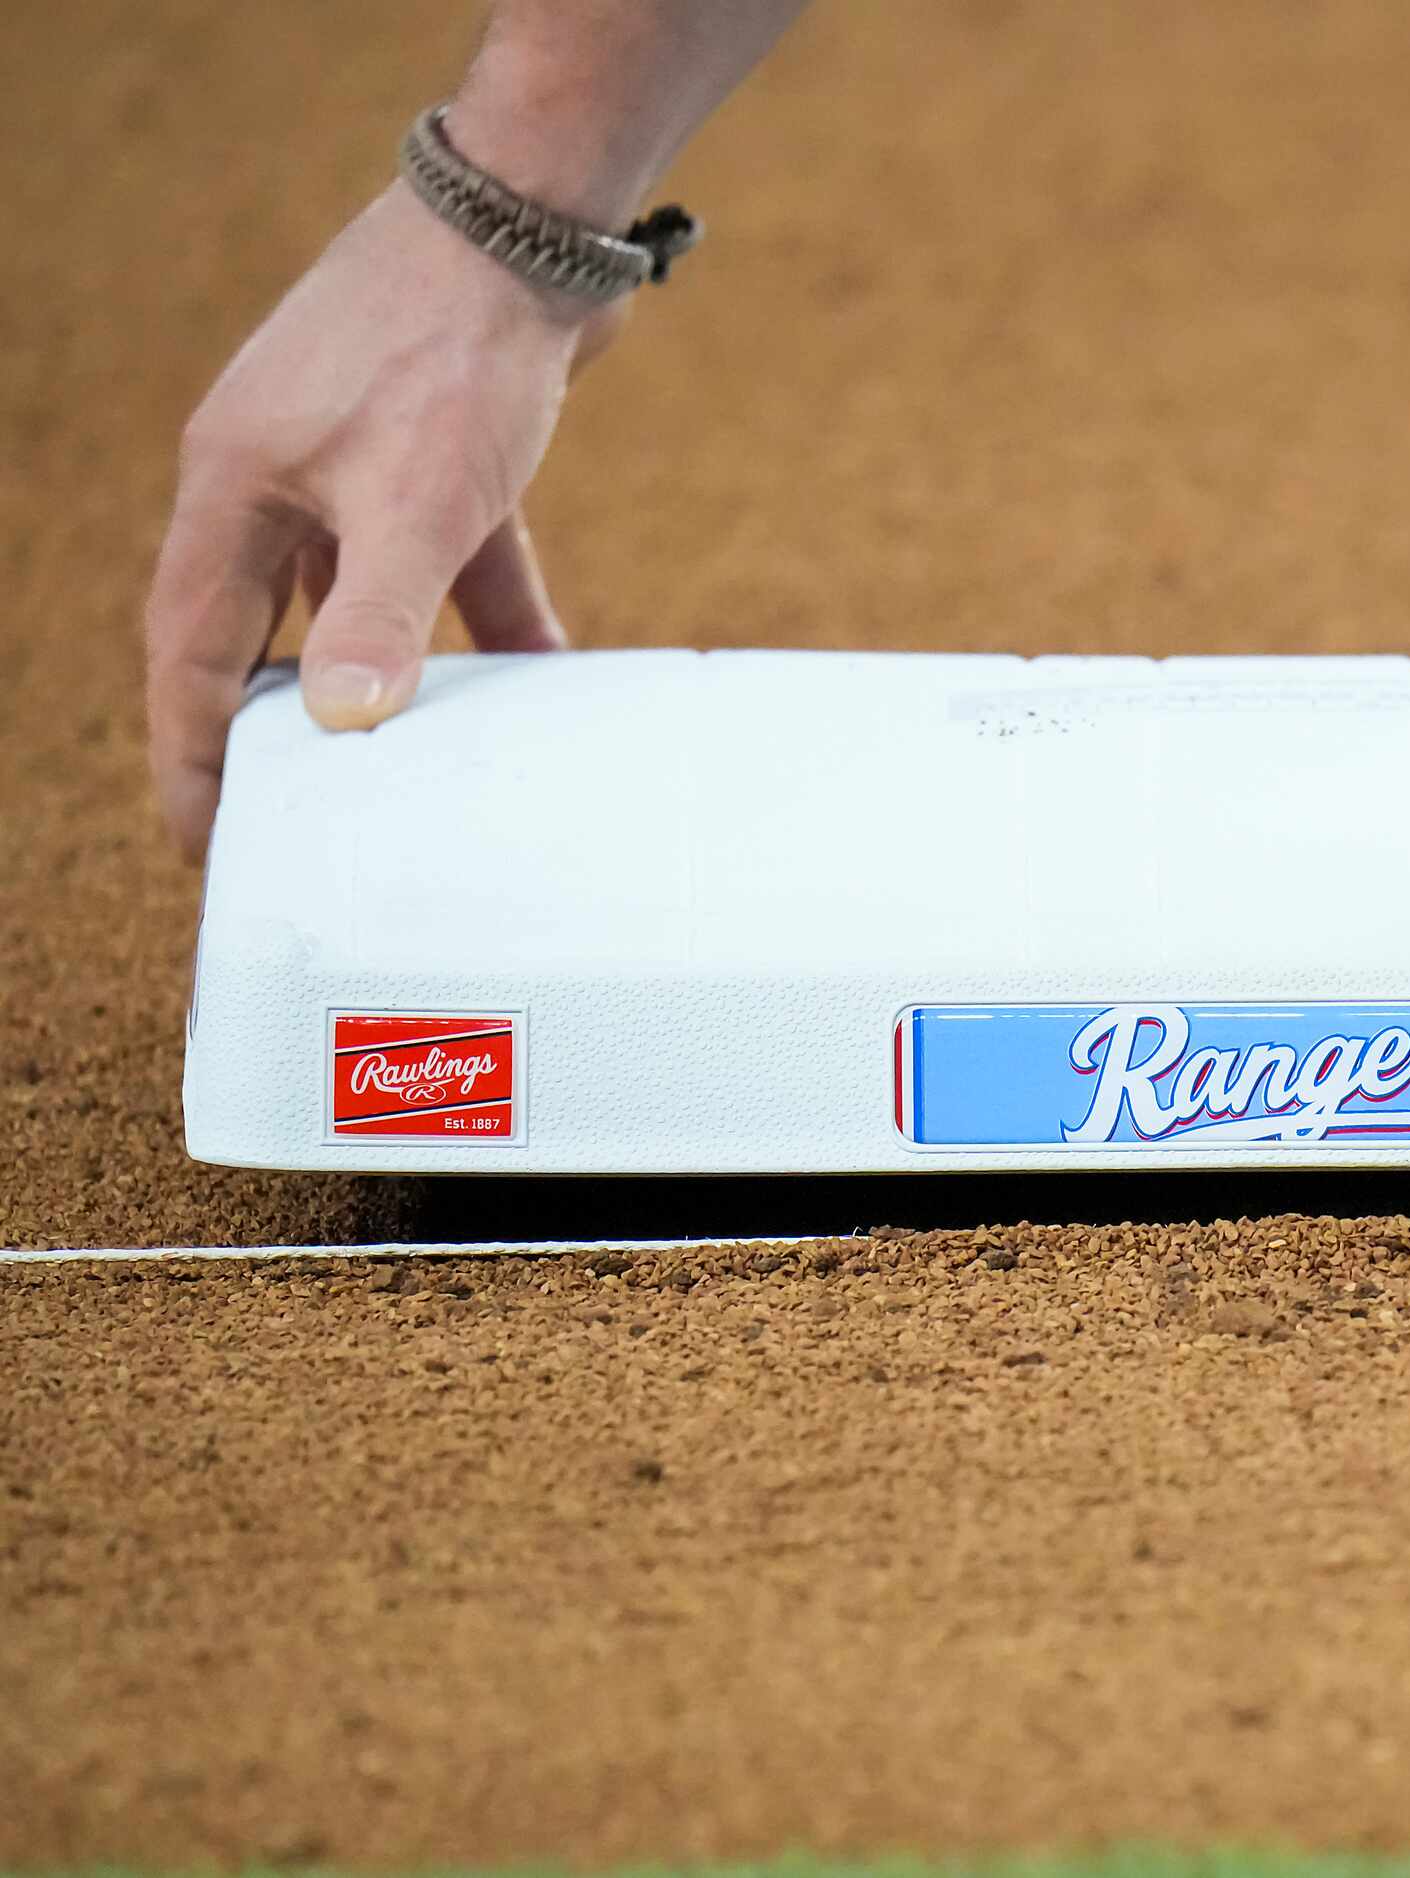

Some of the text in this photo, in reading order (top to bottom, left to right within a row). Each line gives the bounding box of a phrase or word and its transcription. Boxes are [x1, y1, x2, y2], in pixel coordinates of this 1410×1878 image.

[351, 1048, 497, 1095] Rawlings
[444, 1117, 500, 1130] Est. 1887
